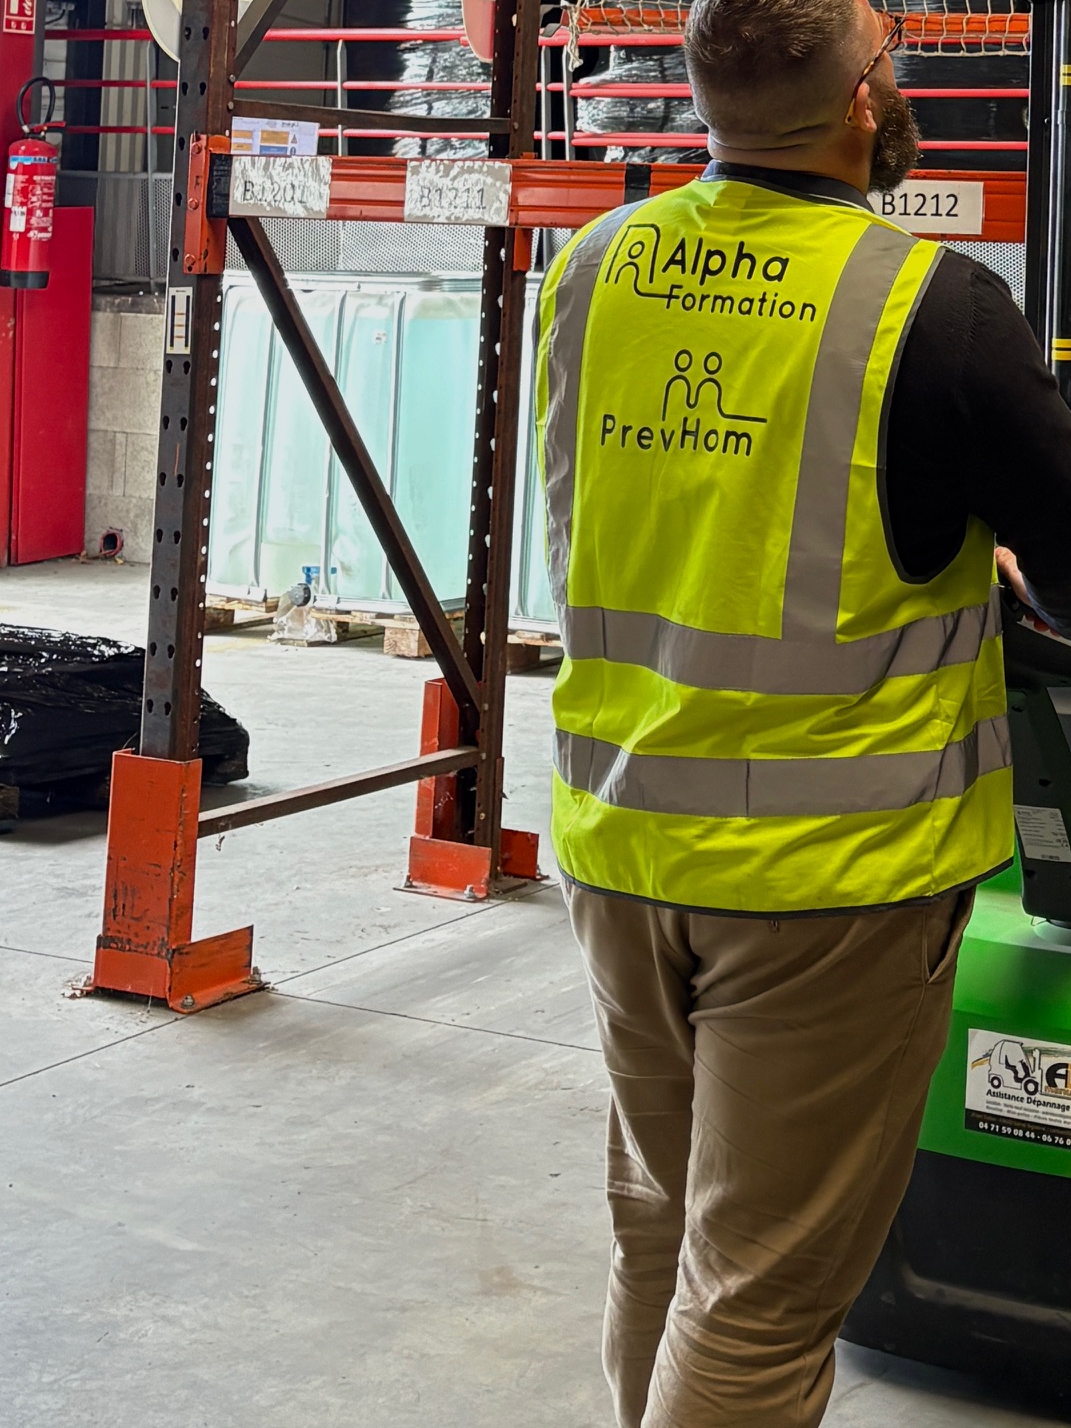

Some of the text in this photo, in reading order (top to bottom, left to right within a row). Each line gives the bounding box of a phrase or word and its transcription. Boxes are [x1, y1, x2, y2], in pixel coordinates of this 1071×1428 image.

[881, 192, 959, 217] B1212
[661, 237, 790, 286] Alpha
[665, 284, 817, 322] Formation
[600, 413, 754, 457] PrevHom
[986, 1089, 1025, 1104] Assistance
[1026, 1097, 1071, 1113] Dépannage
[978, 1121, 989, 1130] 04
[990, 1123, 999, 1132] 71
[1041, 1134, 1053, 1143] 06
